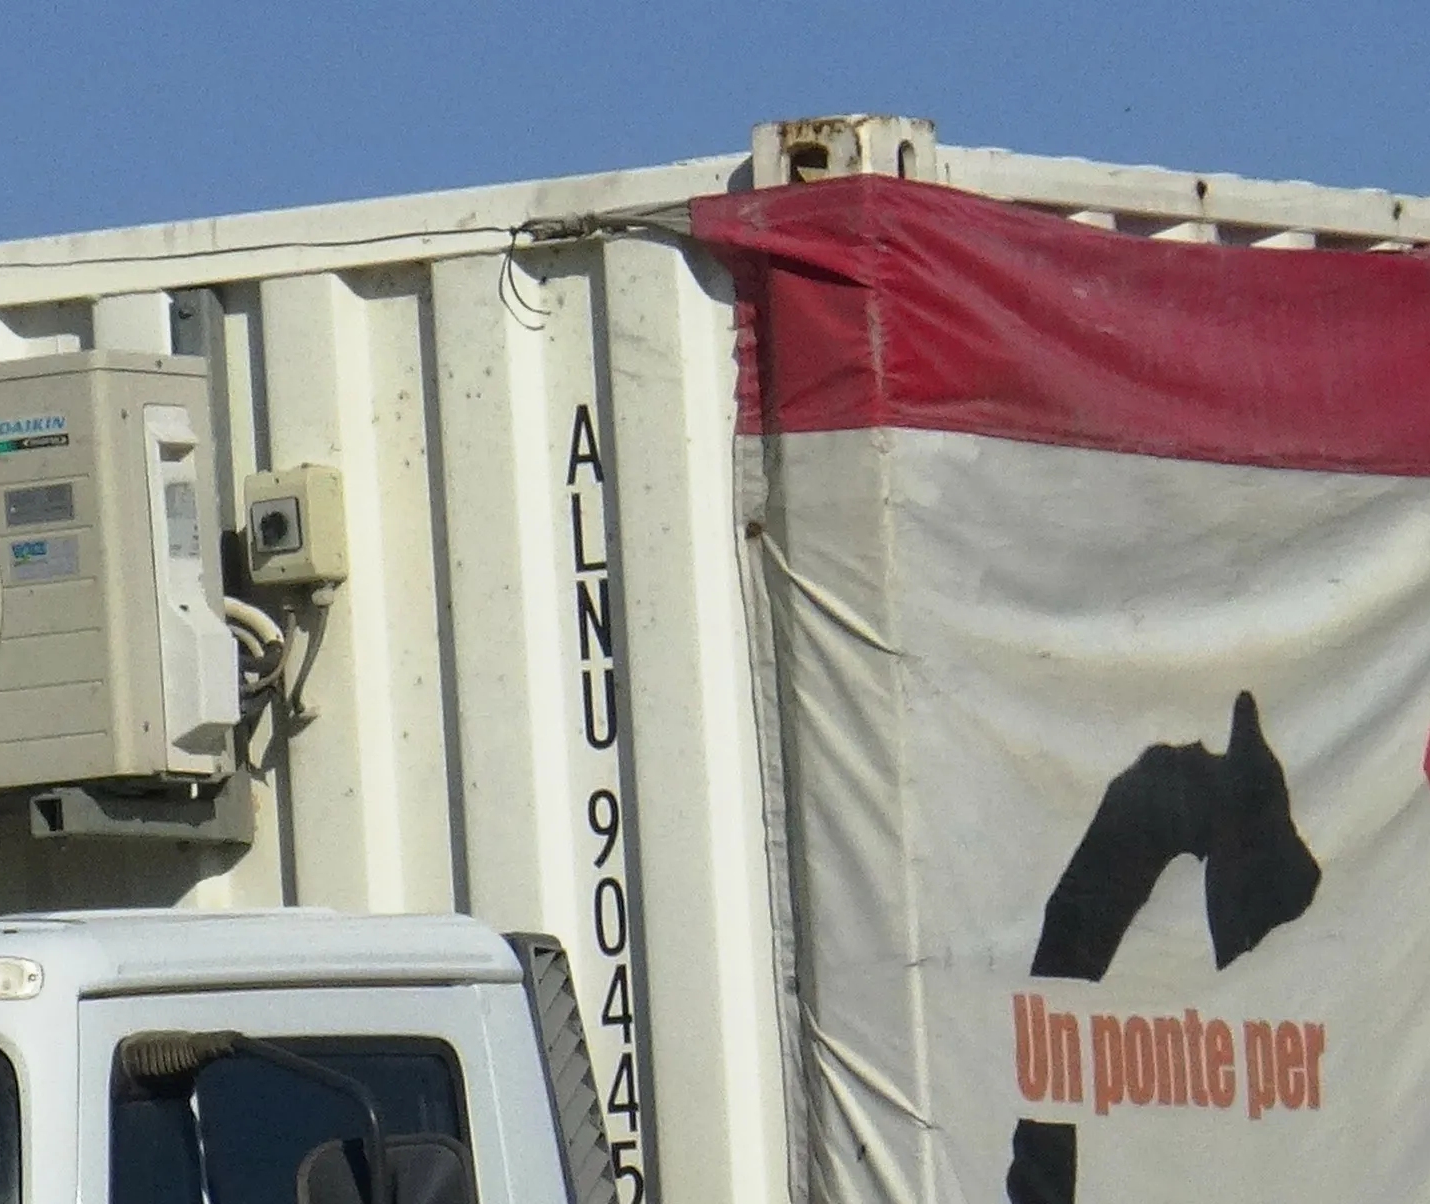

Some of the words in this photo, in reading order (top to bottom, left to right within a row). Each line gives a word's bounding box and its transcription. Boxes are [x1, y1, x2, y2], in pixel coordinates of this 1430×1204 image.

[567, 404, 617, 750] ALNU
[1012, 993, 1084, 1104] Un
[1089, 1007, 1236, 1116] ponte
[1243, 1018, 1325, 1121] per
